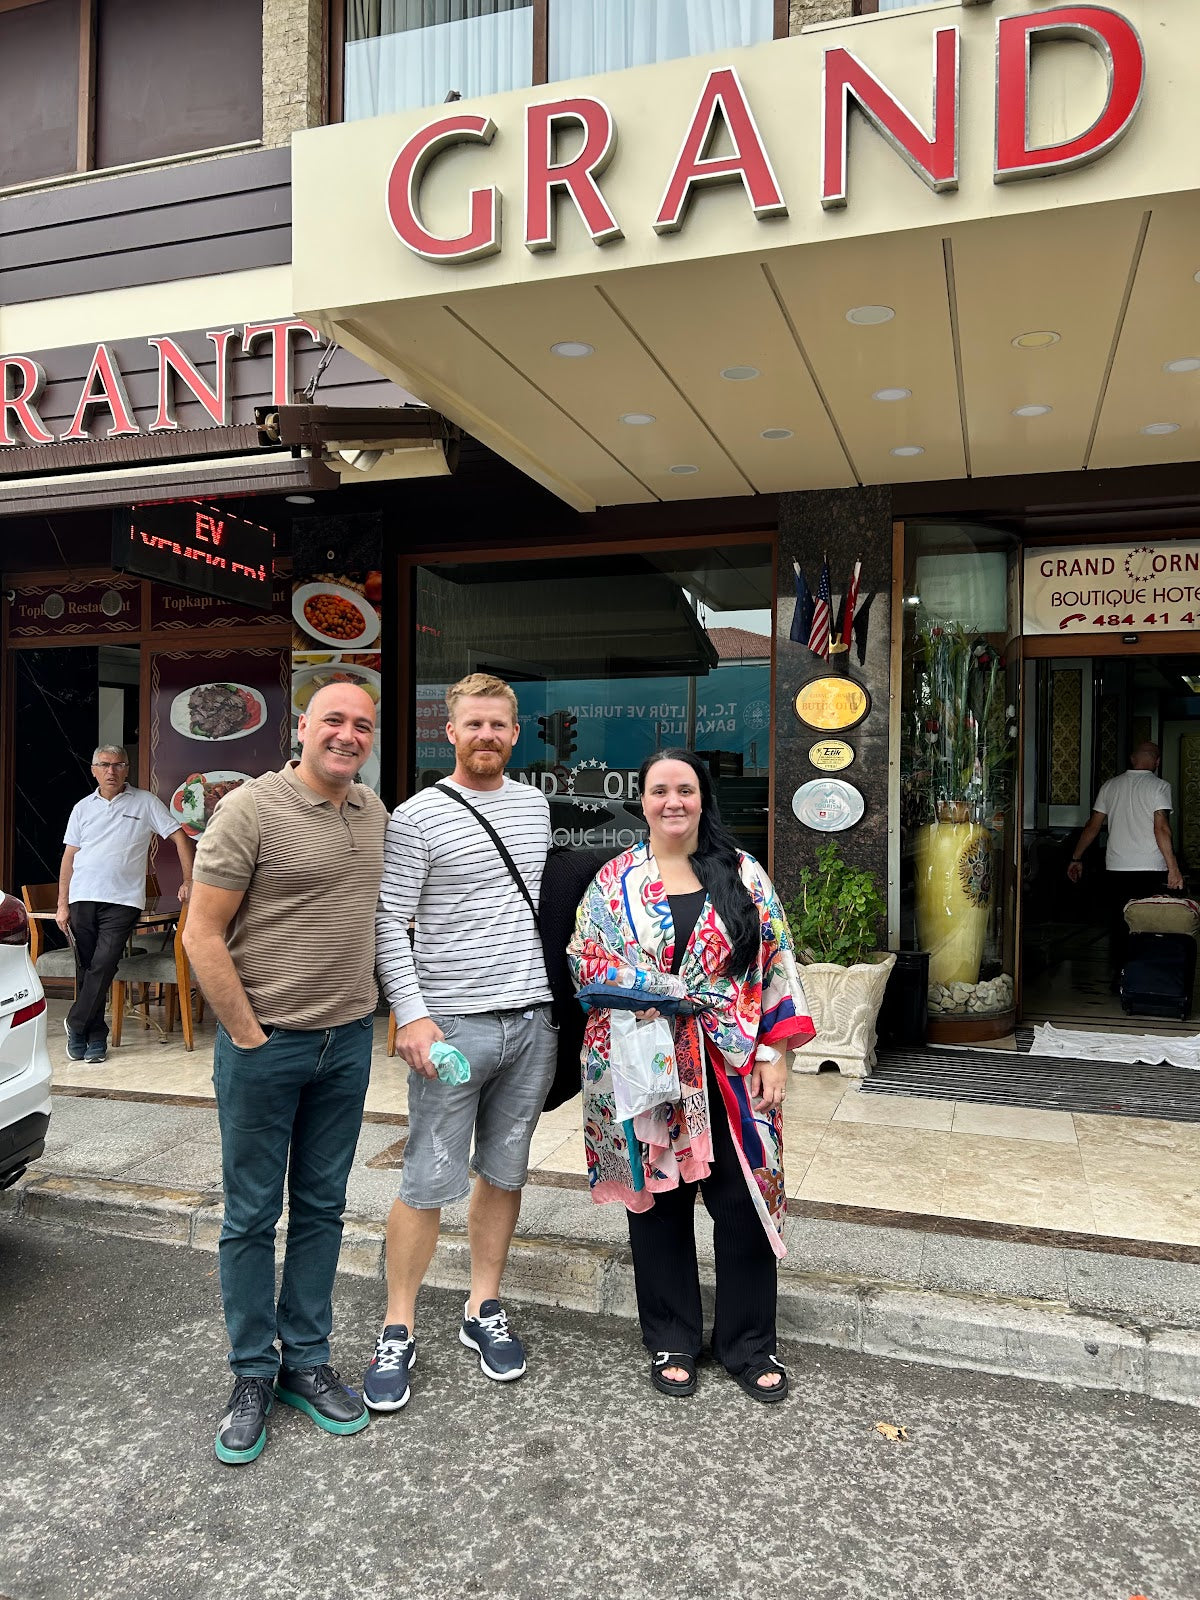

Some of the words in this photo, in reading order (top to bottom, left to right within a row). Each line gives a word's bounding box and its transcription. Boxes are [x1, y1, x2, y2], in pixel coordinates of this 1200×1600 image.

[386, 4, 1146, 265] GRAND
[0, 320, 321, 446] RANT
[195, 512, 224, 545] EV
[1040, 557, 1115, 578] GRAND
[1051, 588, 1146, 608] BOUTIQUE
[1092, 614, 1136, 627] 484
[1142, 612, 1169, 625] 41
